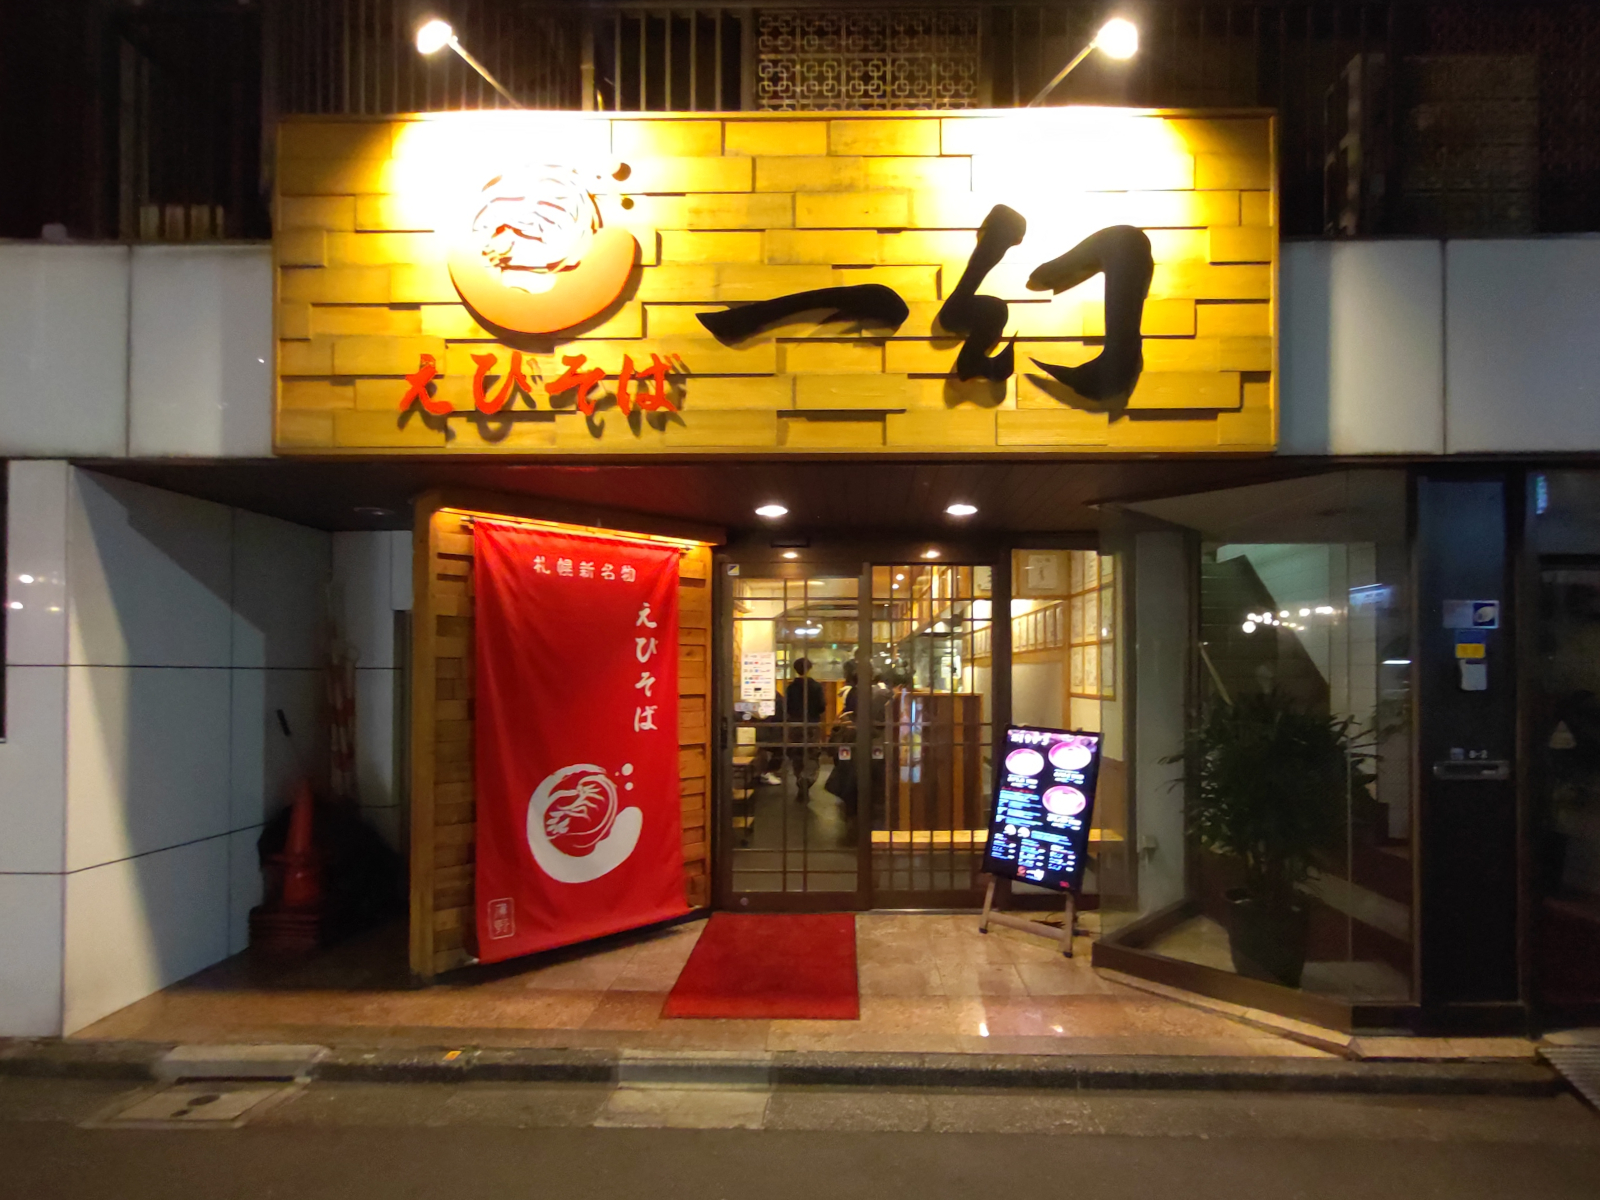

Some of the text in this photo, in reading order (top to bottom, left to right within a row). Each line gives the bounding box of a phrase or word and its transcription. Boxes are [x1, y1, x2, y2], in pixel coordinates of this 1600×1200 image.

[696, 204, 1154, 402] 一幻
[400, 351, 681, 416] えびそば
[533, 555, 637, 583] 札幌新名物
[633, 602, 658, 732] えびそば
